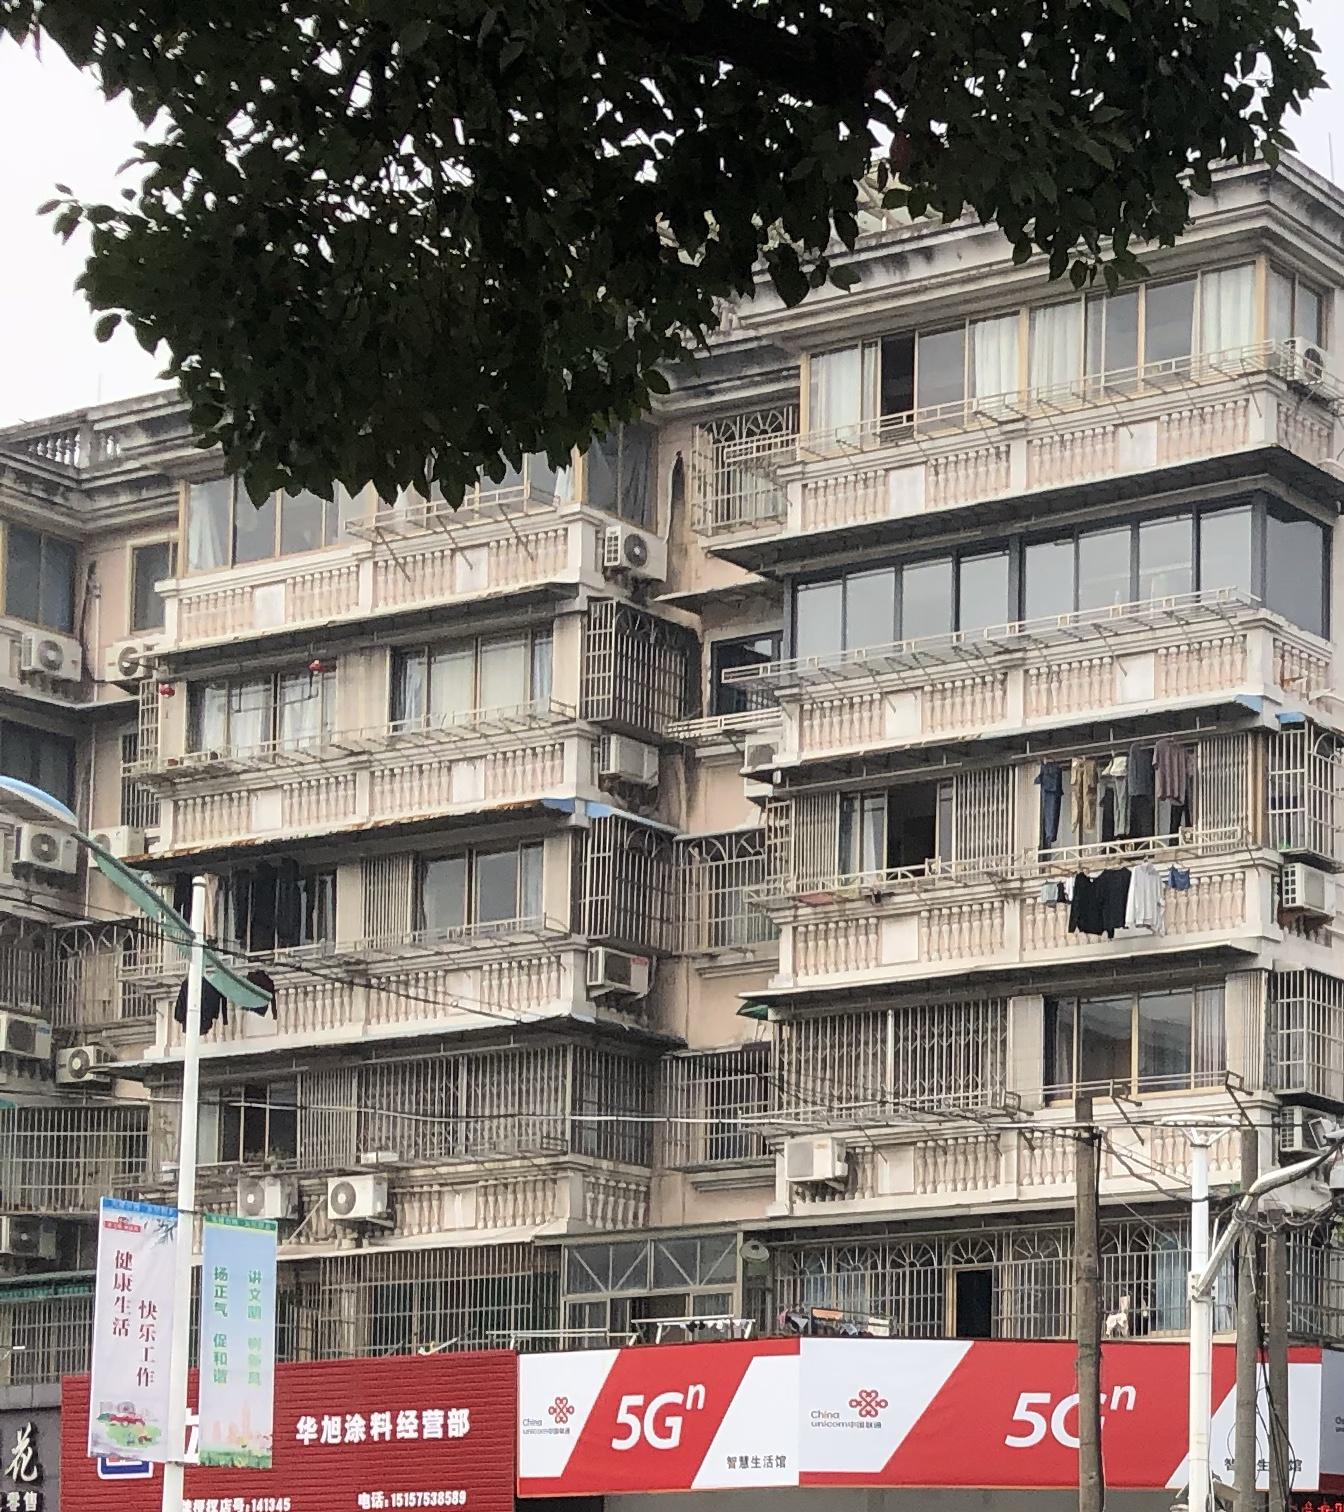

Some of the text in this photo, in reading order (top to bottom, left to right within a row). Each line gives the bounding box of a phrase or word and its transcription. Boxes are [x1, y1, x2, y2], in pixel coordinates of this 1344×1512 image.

[113, 1249, 133, 1337] 健康生活
[213, 1266, 228, 1318] 扬正气
[247, 1270, 262, 1320] 讲文明
[136, 1300, 158, 1387] 快乐工作
[295, 1408, 471, 1445] 华旭涂料经营部
[810, 1409, 840, 1419] China
[5, 1422, 38, 1482] 花
[726, 1455, 787, 1469] 智慧生活馆
[0, 1491, 38, 1512] 零售
